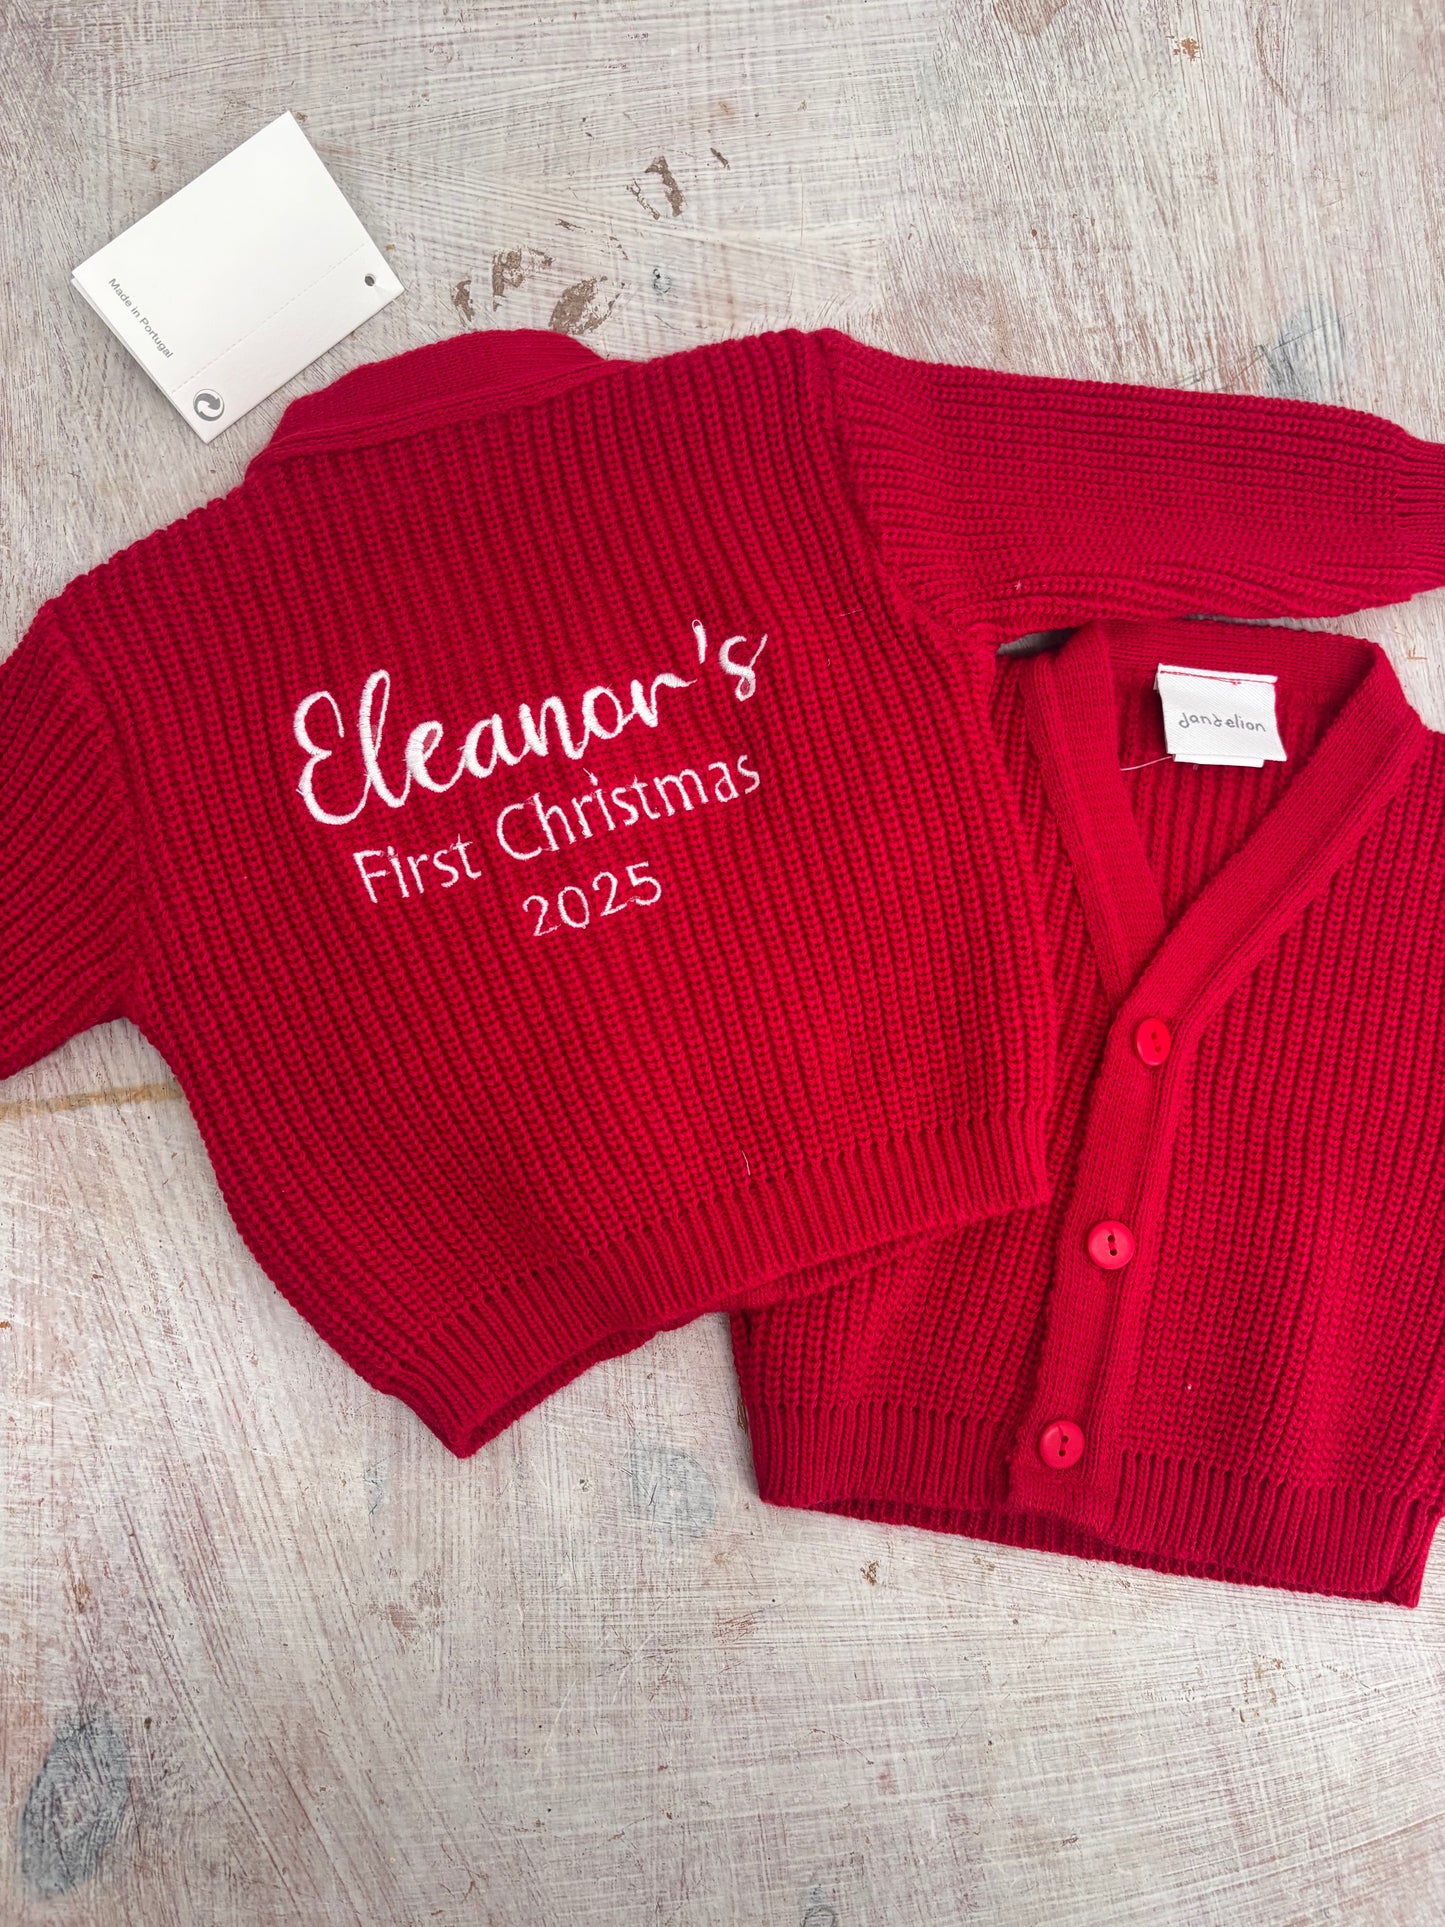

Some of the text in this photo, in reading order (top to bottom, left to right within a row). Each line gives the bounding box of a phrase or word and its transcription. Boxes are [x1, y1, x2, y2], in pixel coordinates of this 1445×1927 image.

[108, 277, 174, 359] Made in Portugal
[293, 619, 768, 826] Eleanor's
[1178, 712, 1266, 732] dandelion
[353, 754, 761, 904] First Christmas
[522, 861, 662, 937] 2025
